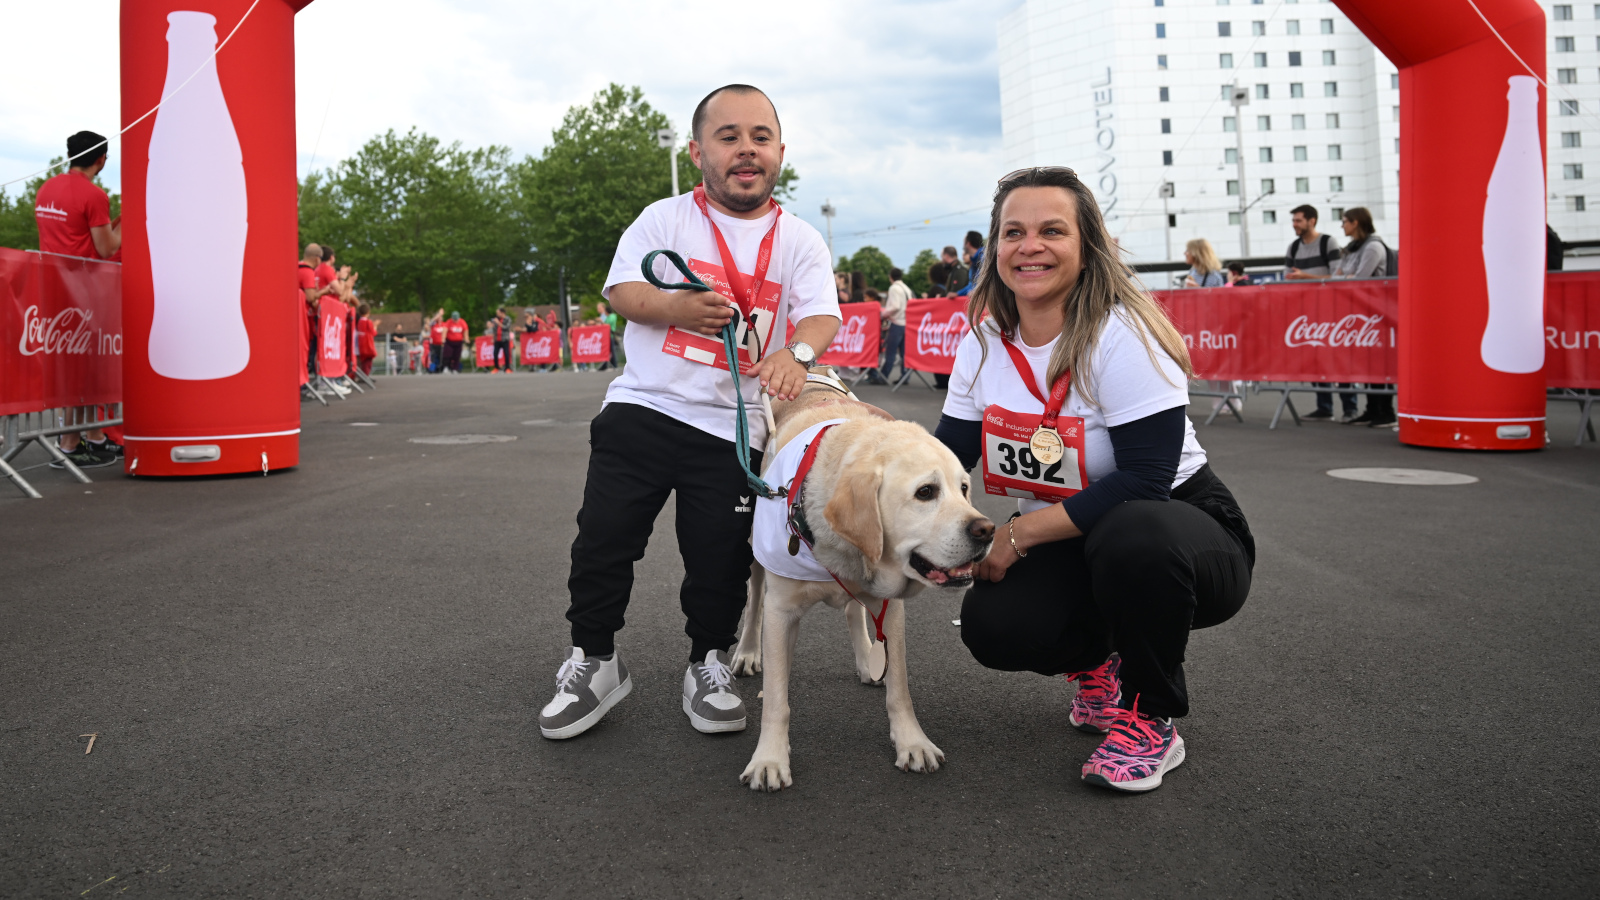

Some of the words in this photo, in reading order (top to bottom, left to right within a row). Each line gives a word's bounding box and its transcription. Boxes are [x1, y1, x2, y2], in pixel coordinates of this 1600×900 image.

[1090, 66, 1119, 222] NOVOTEL
[1200, 330, 1237, 349] Run
[1284, 314, 1384, 348] Coca-Cola
[1546, 326, 1600, 349] Run
[1005, 423, 1032, 433] Inclusion
[997, 442, 1065, 484] 392
